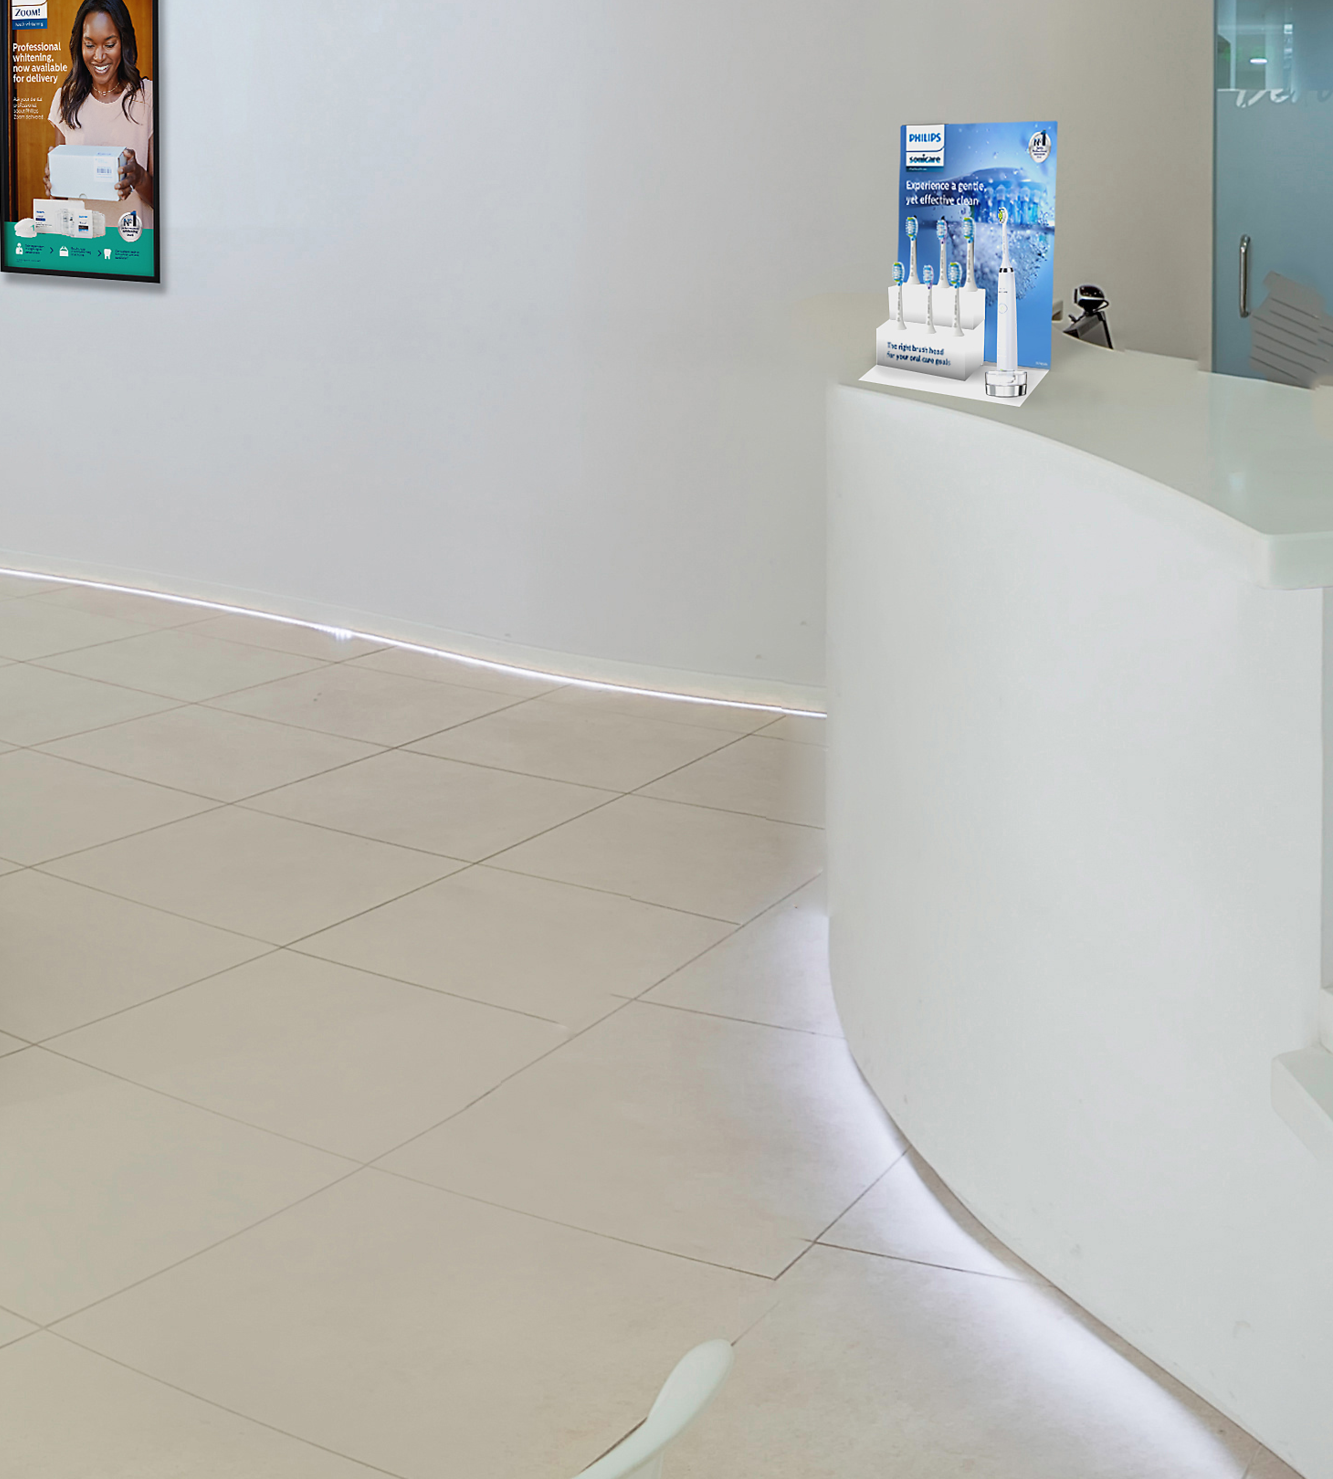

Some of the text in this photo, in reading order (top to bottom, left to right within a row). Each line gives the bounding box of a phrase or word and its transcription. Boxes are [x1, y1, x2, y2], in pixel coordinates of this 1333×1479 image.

[12, 42, 61, 52] Professional
[12, 53, 54, 63] whitening,
[13, 63, 68, 73] now available
[13, 74, 58, 84] for delivery
[909, 133, 941, 143] PHILIPS
[909, 154, 941, 163] sonicare
[906, 180, 949, 192] Experience
[958, 181, 987, 193] gentle,
[906, 194, 979, 206] yet effective clean
